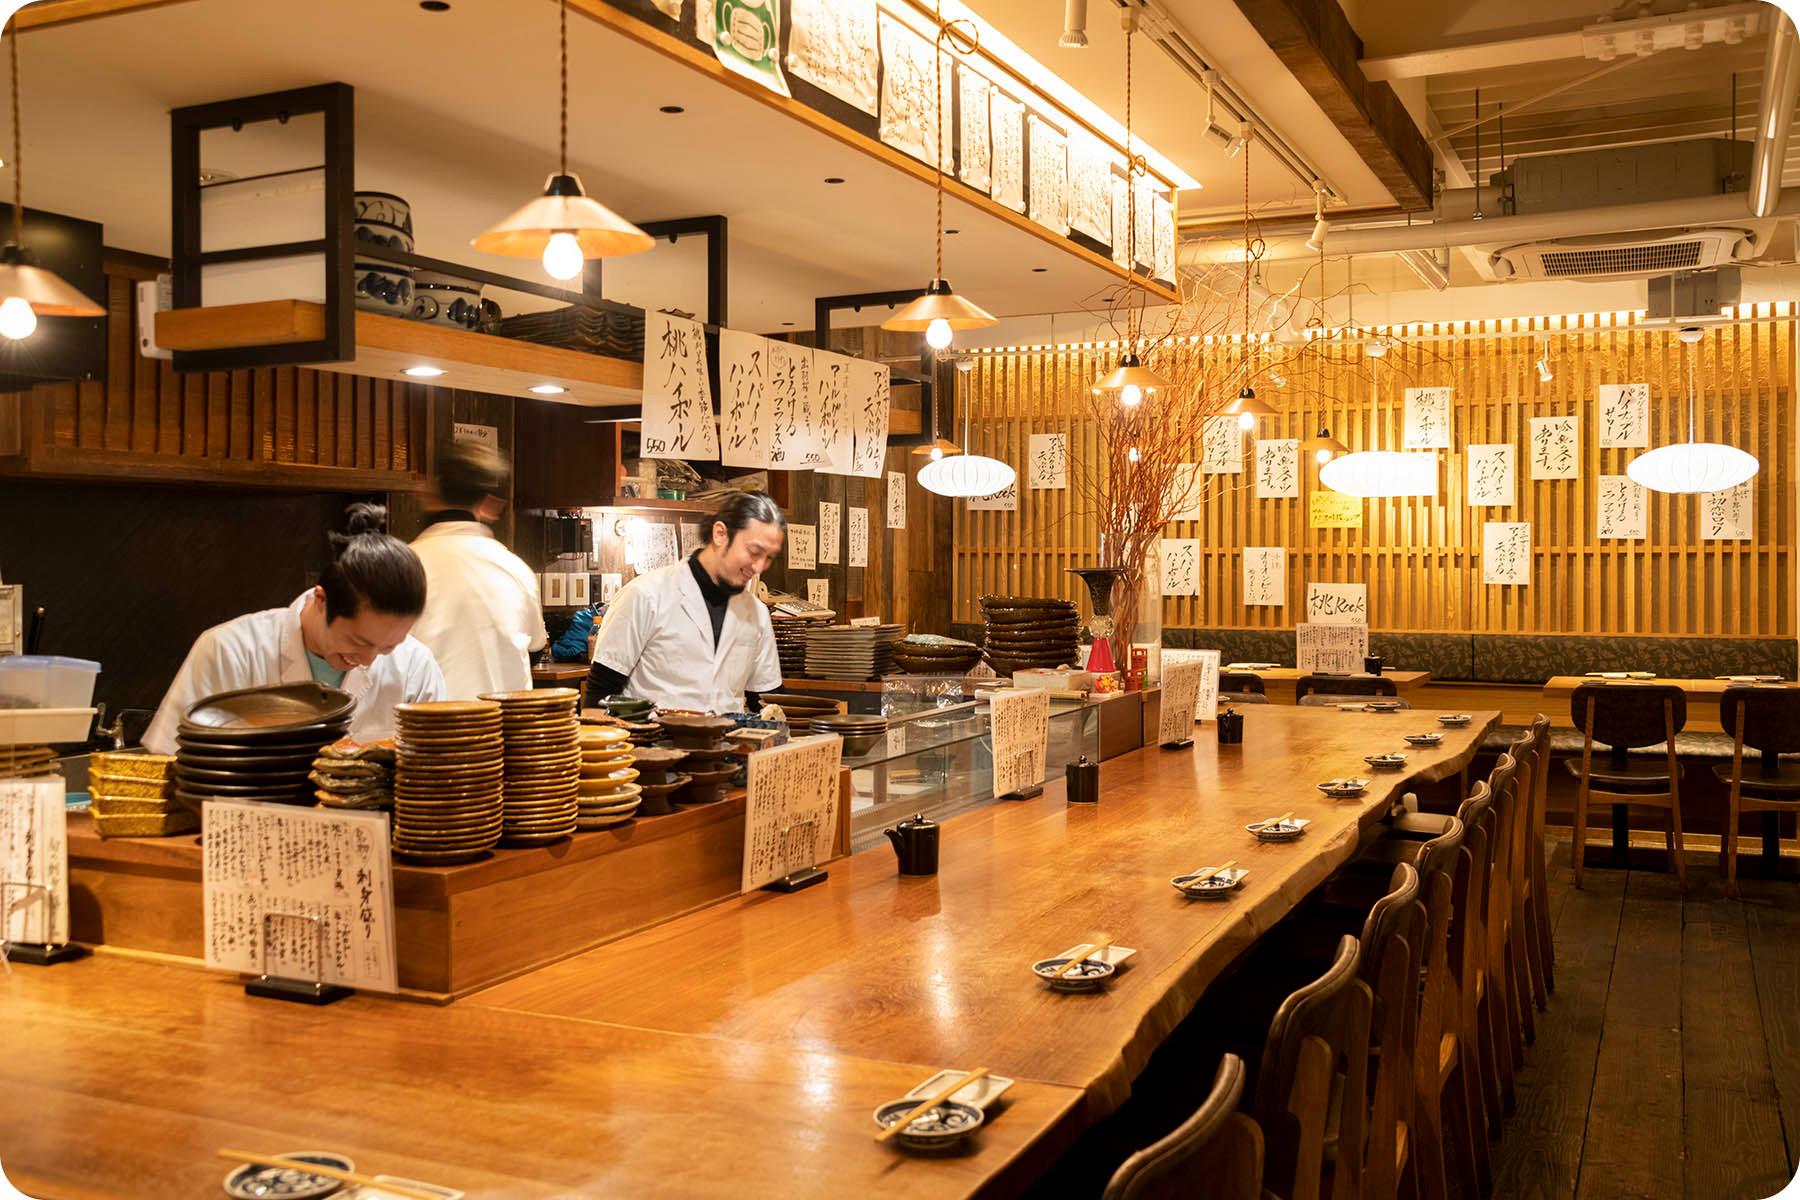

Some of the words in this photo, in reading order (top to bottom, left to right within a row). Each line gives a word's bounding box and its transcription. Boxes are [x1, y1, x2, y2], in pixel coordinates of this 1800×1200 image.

[660, 319, 695, 452] 桃ハイボール
[727, 363, 747, 451] ハイボール
[748, 351, 764, 450] スパイス
[786, 357, 797, 437] とろける
[831, 364, 841, 444] アールグレイ
[771, 372, 785, 462] ラフランス酒
[864, 397, 874, 459] 天ぷら
[1416, 390, 1436, 445] 桃ハイボール
[1616, 388, 1635, 440] パイナップル
[646, 438, 666, 453] 550
[805, 452, 820, 461] 550
[1491, 451, 1508, 498] スパイス
[1708, 492, 1727, 536] い初恋ロック
[1180, 545, 1195, 588] スパイス
[1261, 551, 1272, 601] オリオンビール
[1495, 541, 1506, 575] 天ぷら
[1506, 527, 1519, 580] アイスクリームの
